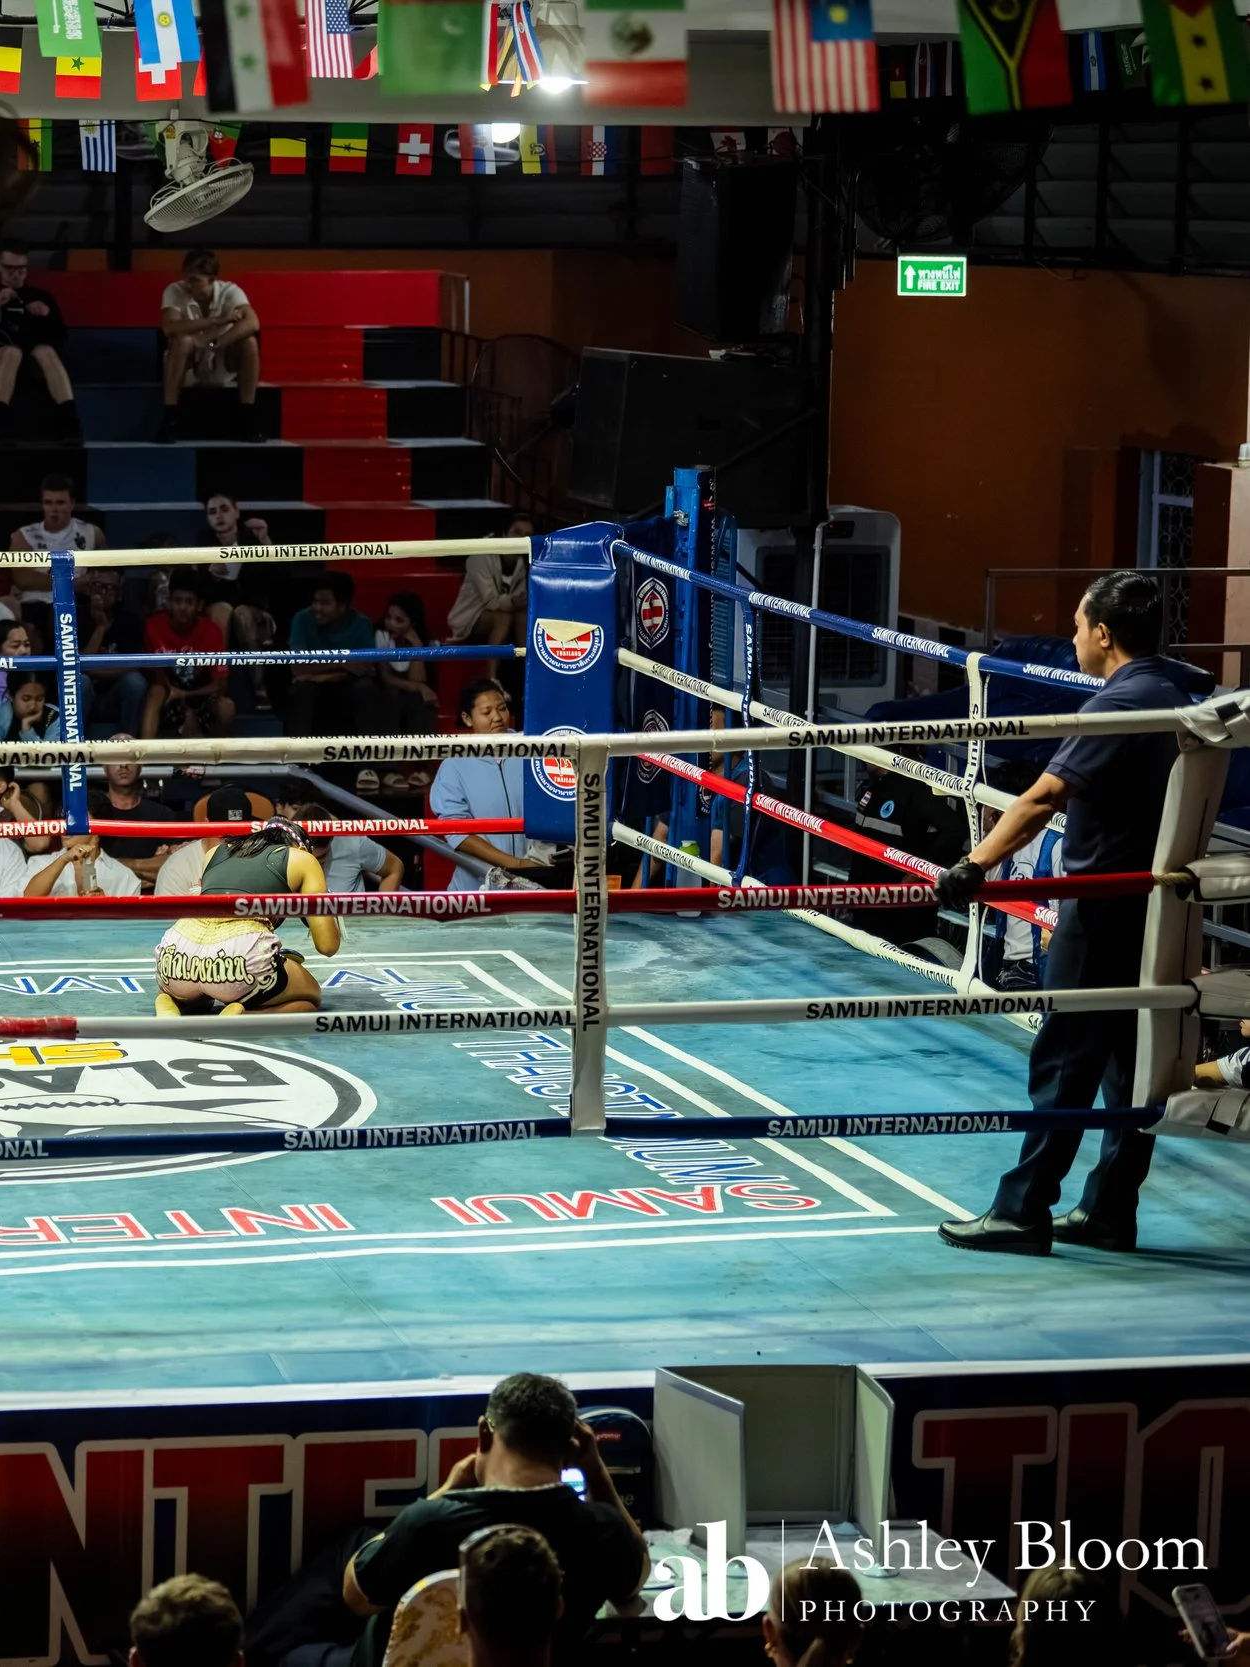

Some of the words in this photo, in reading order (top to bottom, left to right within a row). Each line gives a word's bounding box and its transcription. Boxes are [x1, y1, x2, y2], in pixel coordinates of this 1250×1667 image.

[918, 280, 937, 291] FIRE
[940, 280, 961, 291] EXIT
[219, 546, 270, 559] SAMUI
[275, 544, 393, 558] INTERNATIONAL
[60, 613, 76, 666] SAMUI
[871, 626, 897, 645] SAMUI
[895, 632, 951, 659] INTERNATIONAL
[556, 649, 582, 657] THAILAND
[1023, 663, 1052, 680] SAMUI
[1051, 667, 1106, 688] INTERNATION
[63, 670, 82, 792] INTERNATNAL
[788, 729, 858, 748] SAMUI
[865, 719, 1030, 745] INTERNATIONAL
[323, 744, 394, 761] SAMUI
[402, 742, 572, 760] INTERNATIONAL
[553, 776, 576, 784] THAILA
[891, 755, 915, 774] SAMUI
[914, 762, 963, 792] INTERNATION
[583, 773, 601, 848] SAMUI
[755, 793, 778, 811] SAMUI
[776, 801, 826, 833] INTERNATIONAL
[307, 819, 429, 833] INTERNATIONAL
[636, 835, 654, 851] SAMUI
[652, 842, 696, 872] INTERNATIONAL
[883, 847, 908, 866] SAMUI
[906, 854, 949, 878] INTERNAT
[234, 897, 309, 916] SAMUI
[315, 894, 492, 915] INTERNATIONAL
[717, 889, 790, 908] SAMUI
[796, 884, 938, 906] INTERNATION
[1034, 906, 1059, 927] SAMU
[582, 855, 601, 1032] INTERNATIONAL
[806, 1001, 880, 1019] SAMUI
[886, 996, 1059, 1018] INTERNATIONAL
[315, 1014, 391, 1034] SAMUI
[398, 1008, 577, 1031] INTERNATIONAL
[283, 1128, 359, 1150] SAMUI
[365, 1121, 541, 1148] INTERNATIONAL
[767, 1117, 839, 1138] SAMUI
[847, 1114, 1013, 1136] INTERNATIONAL
[430, 1182, 822, 1227] SAMUI
